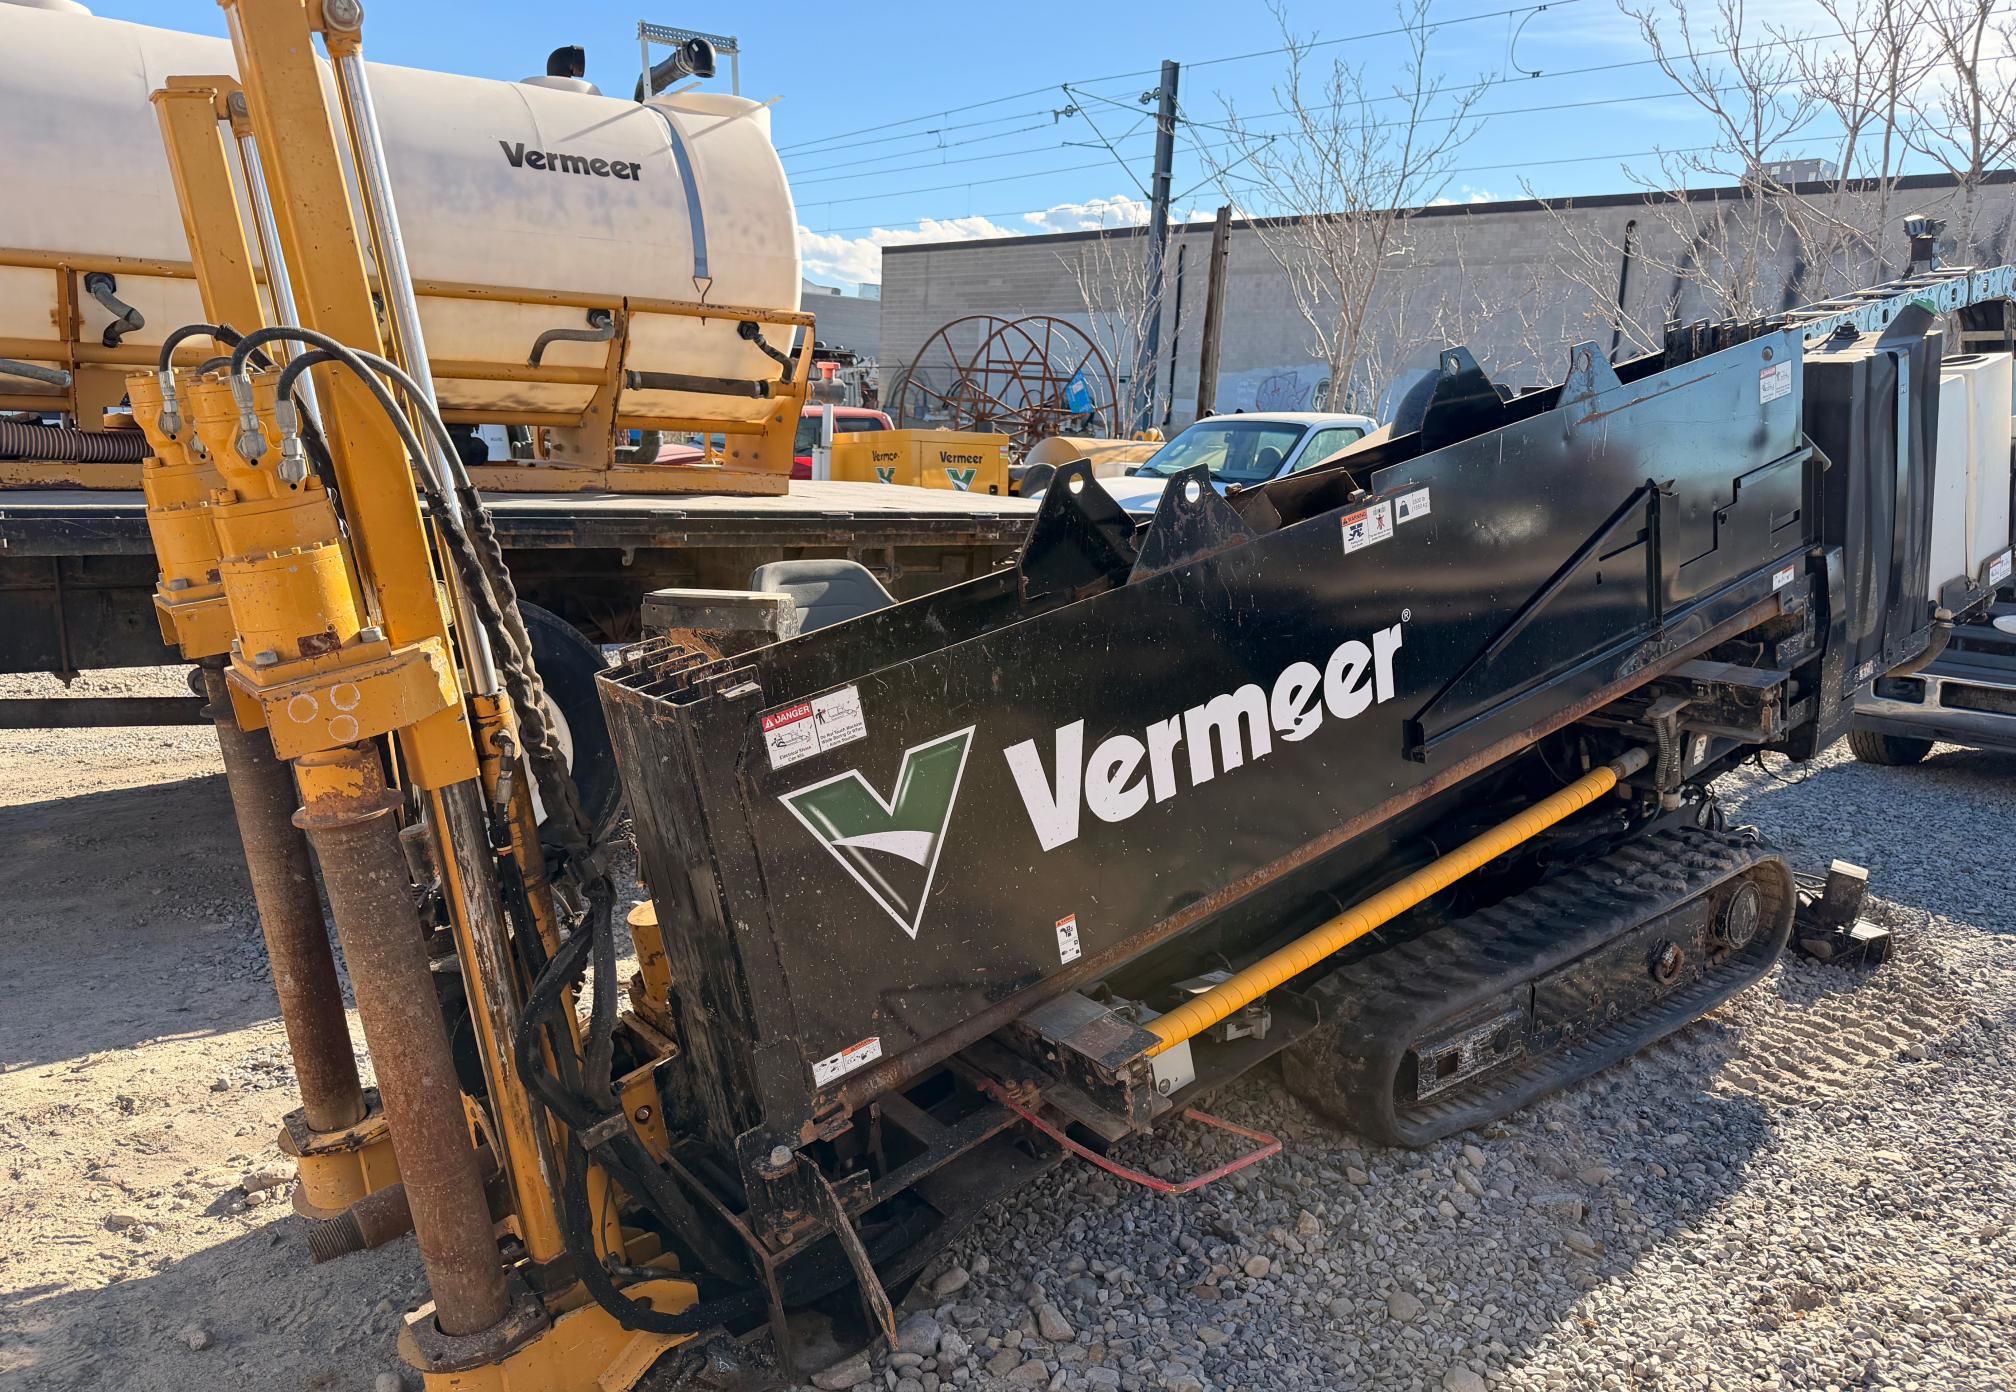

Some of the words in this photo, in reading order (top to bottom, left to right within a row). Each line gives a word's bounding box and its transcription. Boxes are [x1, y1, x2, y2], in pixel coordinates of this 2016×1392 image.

[498, 140, 642, 181] Vermeer
[872, 450, 900, 461] Vermee
[940, 451, 983, 464] Vermeer
[774, 705, 810, 724] DANGER
